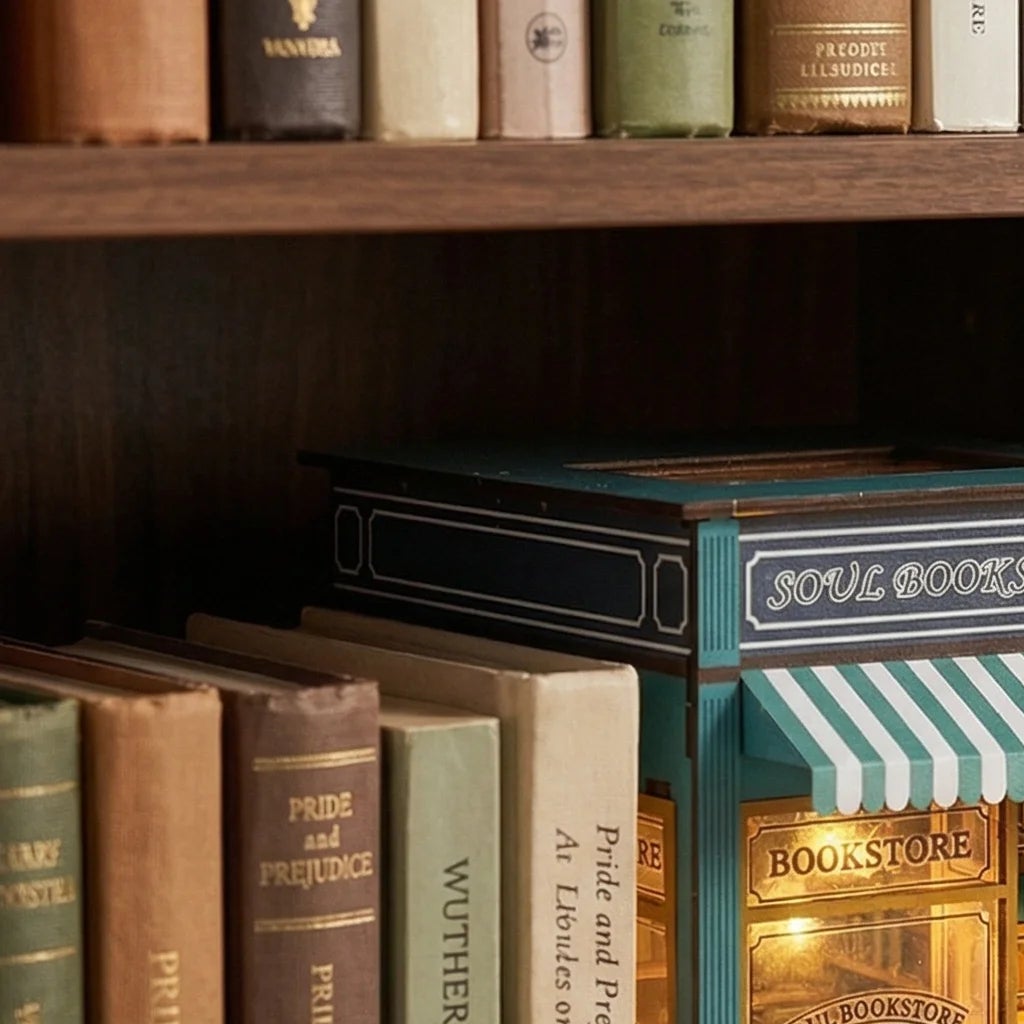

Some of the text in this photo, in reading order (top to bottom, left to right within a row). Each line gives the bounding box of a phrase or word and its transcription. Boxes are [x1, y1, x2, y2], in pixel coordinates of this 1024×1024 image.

[767, 562, 884, 611] SOUL
[289, 792, 353, 823] PRIDE
[304, 824, 340, 850] and
[768, 831, 973, 879] BOOKSTORE
[259, 851, 374, 891] PREJUDICE
[596, 824, 621, 903] Pride
[595, 911, 619, 967] and
